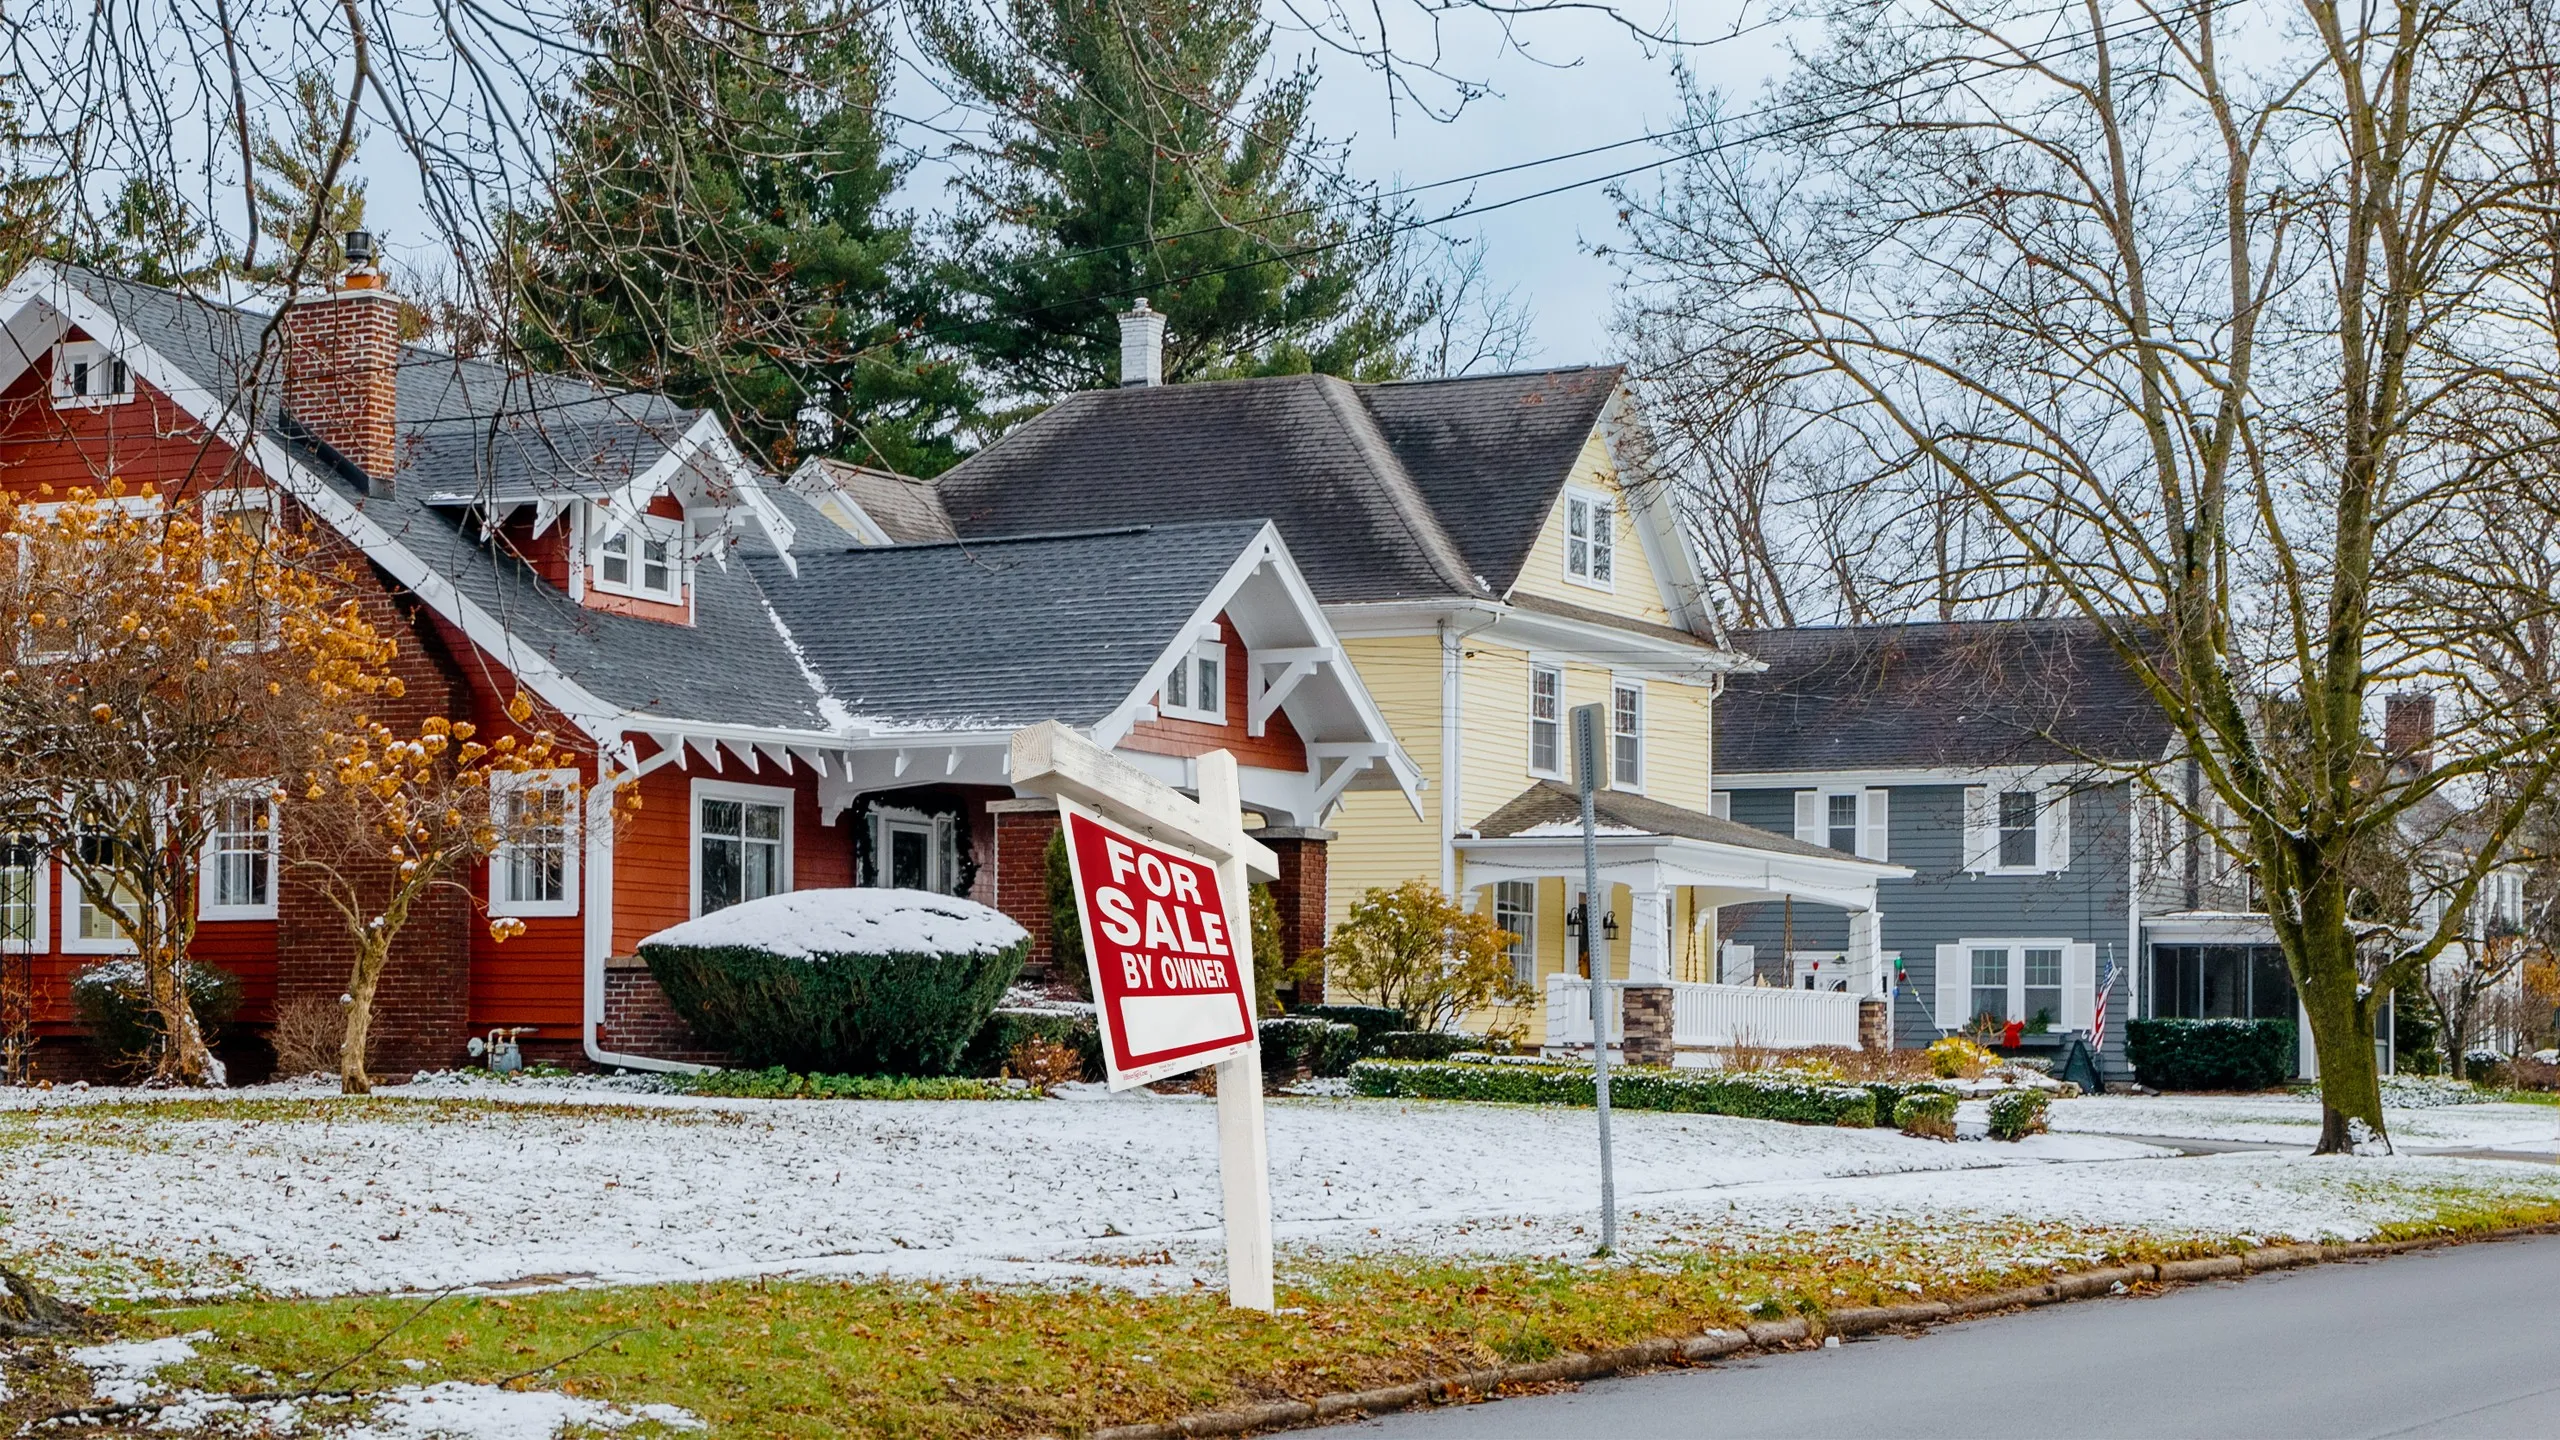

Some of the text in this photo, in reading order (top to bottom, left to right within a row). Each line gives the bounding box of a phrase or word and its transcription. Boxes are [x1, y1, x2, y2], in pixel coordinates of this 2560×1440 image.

[1104, 836, 1203, 906] FOR
[1095, 886, 1229, 955] SALE
[1120, 952, 1229, 989] BY OWNER
